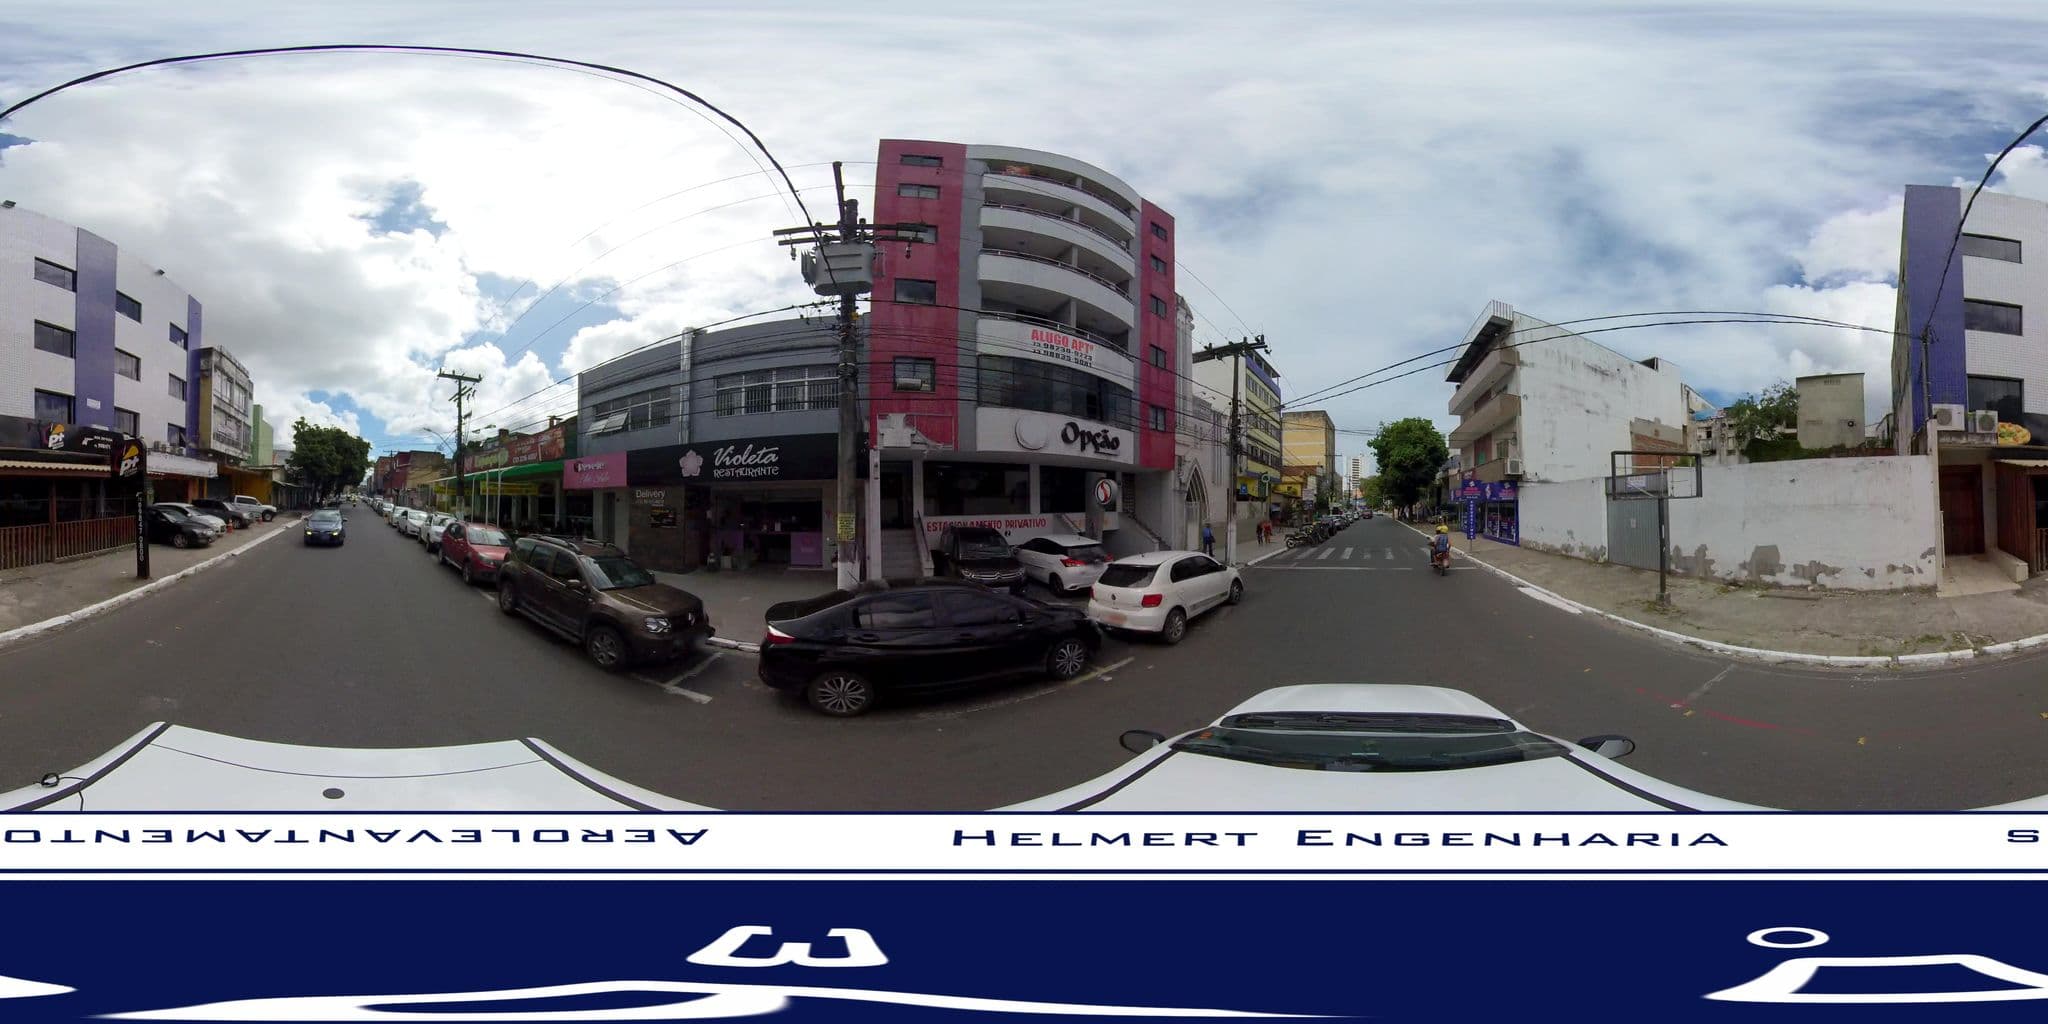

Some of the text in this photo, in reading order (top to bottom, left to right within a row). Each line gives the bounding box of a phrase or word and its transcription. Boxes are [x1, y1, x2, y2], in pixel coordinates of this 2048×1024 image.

[1031, 328, 1069, 347] ALUGO
[1060, 421, 1121, 454] Opção
[713, 443, 779, 466] Violeta
[713, 466, 779, 479] RESTAURANTE
[635, 489, 666, 500] Delivery
[1005, 518, 1047, 529] PRIVATIVO
